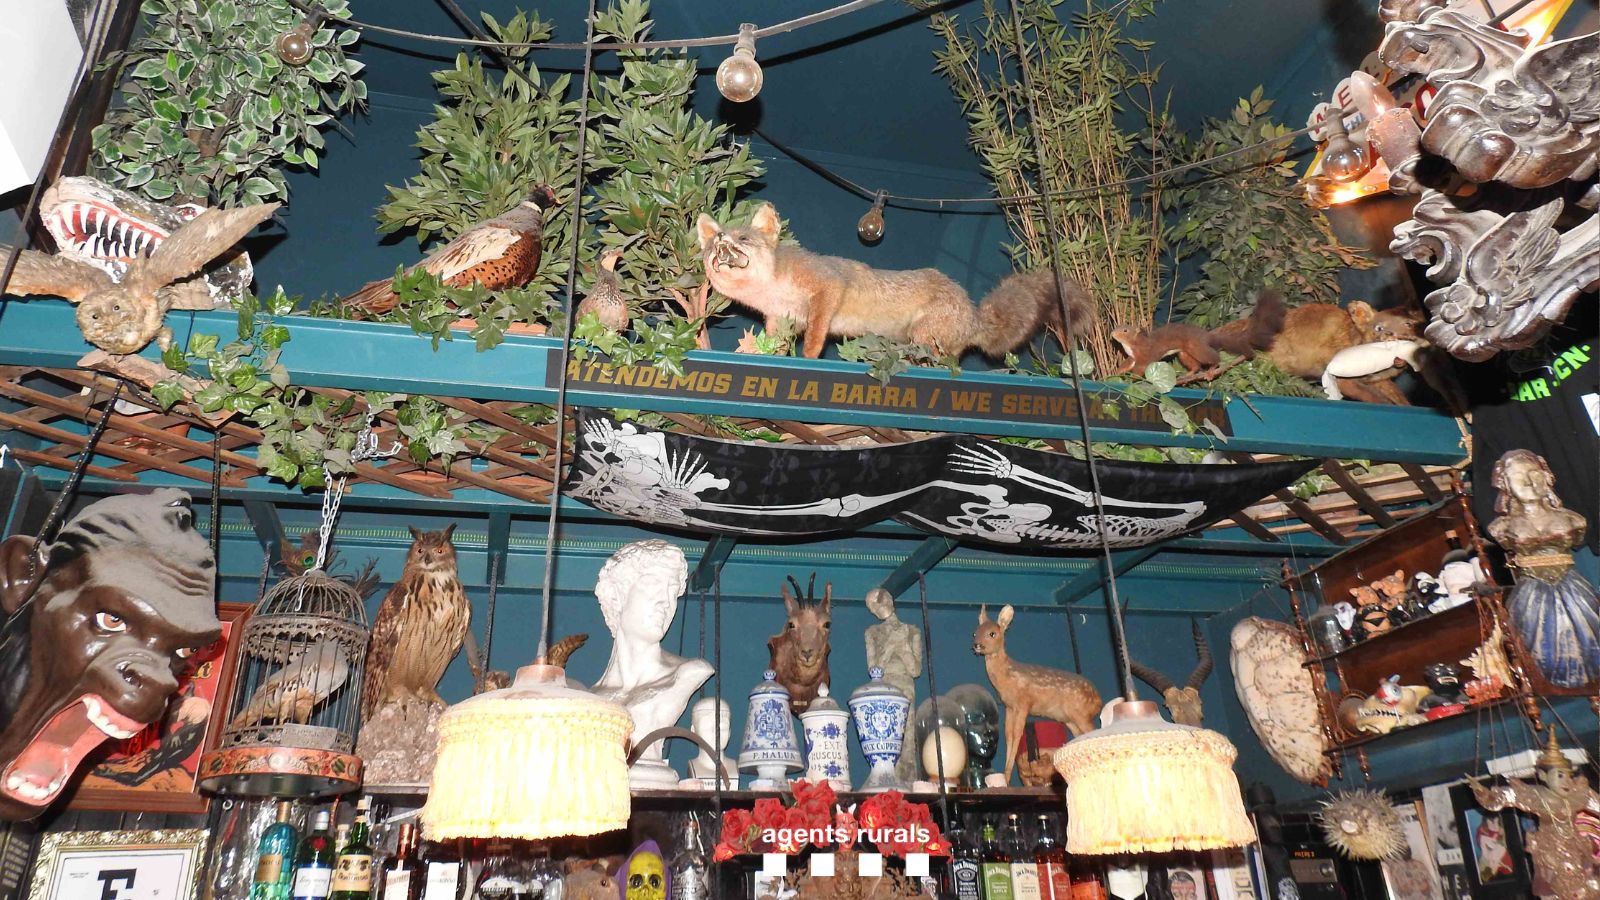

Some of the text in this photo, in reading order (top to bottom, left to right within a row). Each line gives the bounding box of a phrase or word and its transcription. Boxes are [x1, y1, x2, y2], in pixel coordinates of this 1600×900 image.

[566, 359, 732, 395] ATENDEMOS
[741, 375, 779, 399] EN
[788, 379, 819, 402] LA
[830, 383, 917, 409] BARRA
[951, 391, 992, 413] WE
[1001, 394, 1083, 418] SERVE
